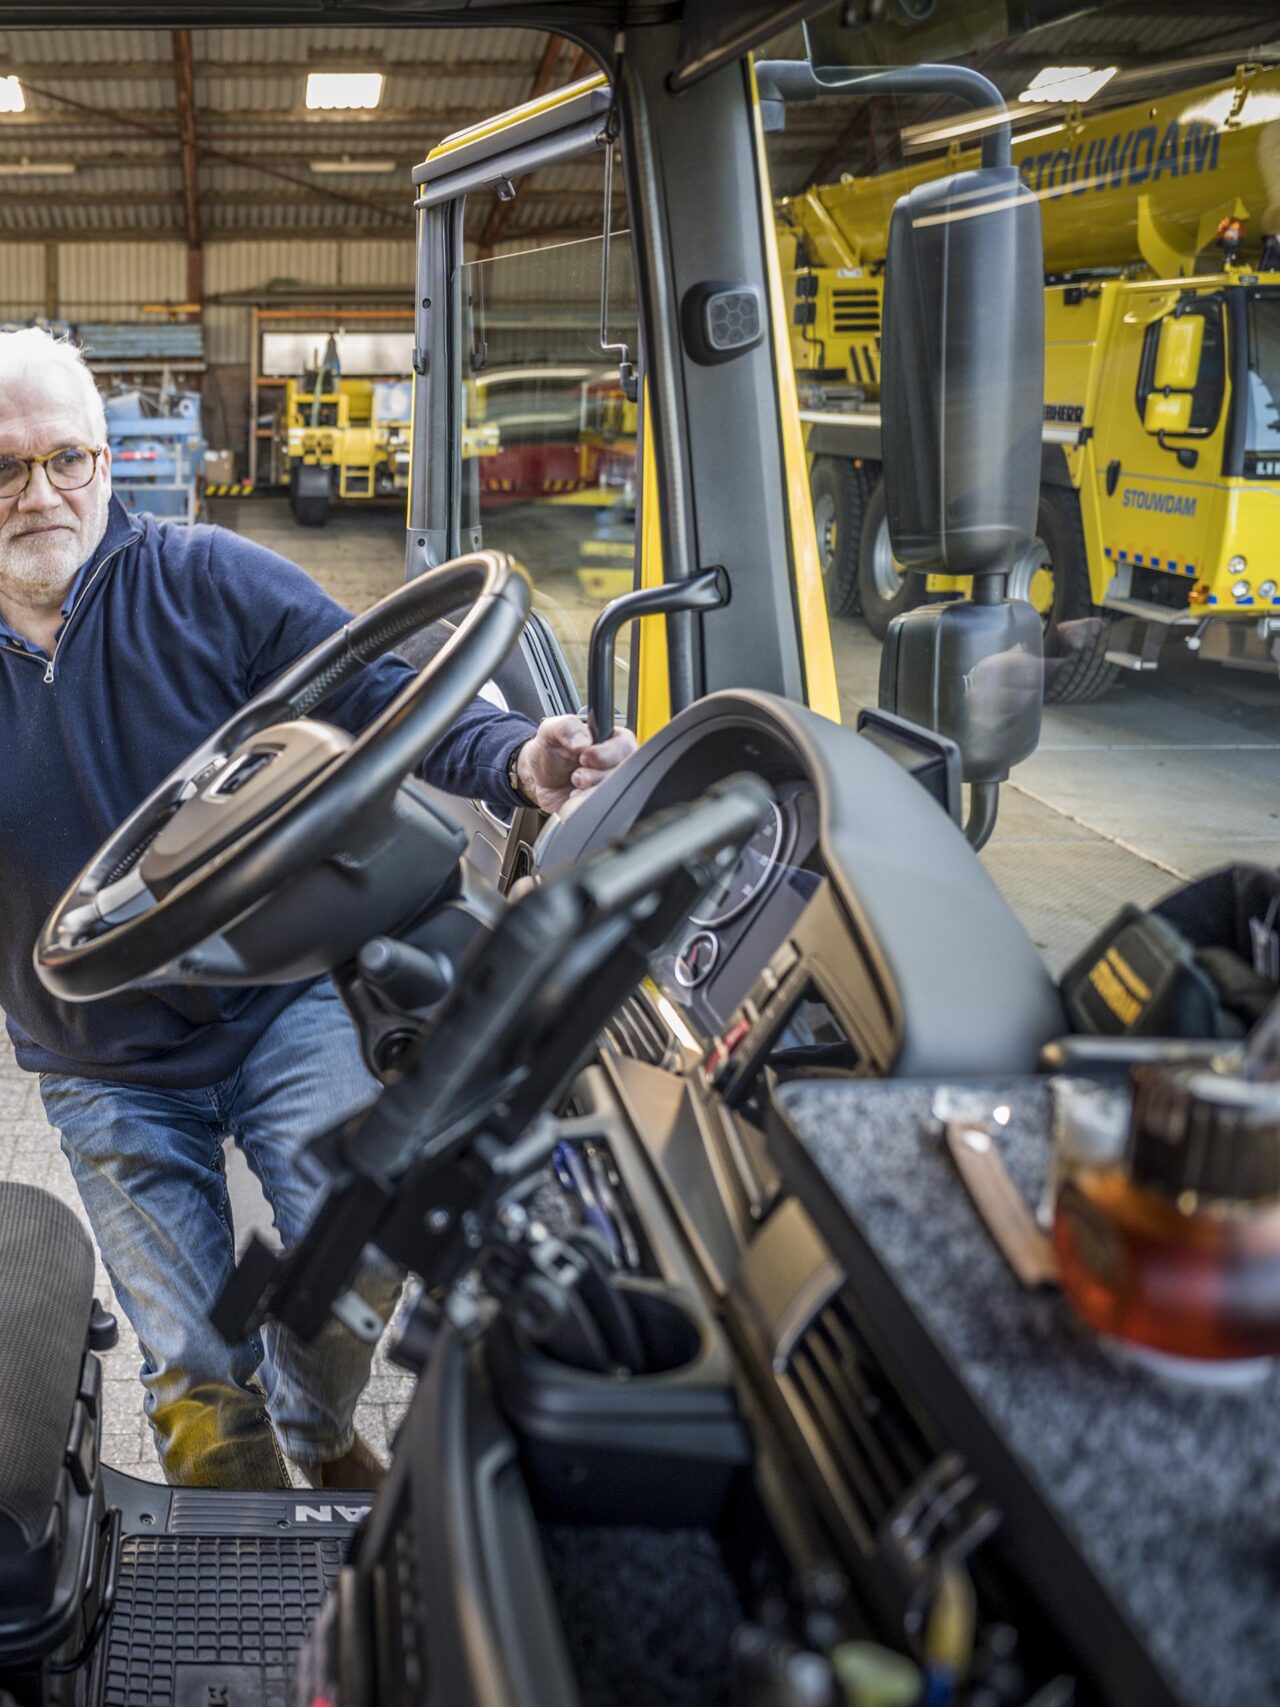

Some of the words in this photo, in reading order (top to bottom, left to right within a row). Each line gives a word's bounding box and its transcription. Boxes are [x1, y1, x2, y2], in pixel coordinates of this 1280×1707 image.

[1020, 120, 1220, 200] STOUWDAM
[1123, 489, 1197, 517] STOUWDAM
[295, 1505, 373, 1522] AN
